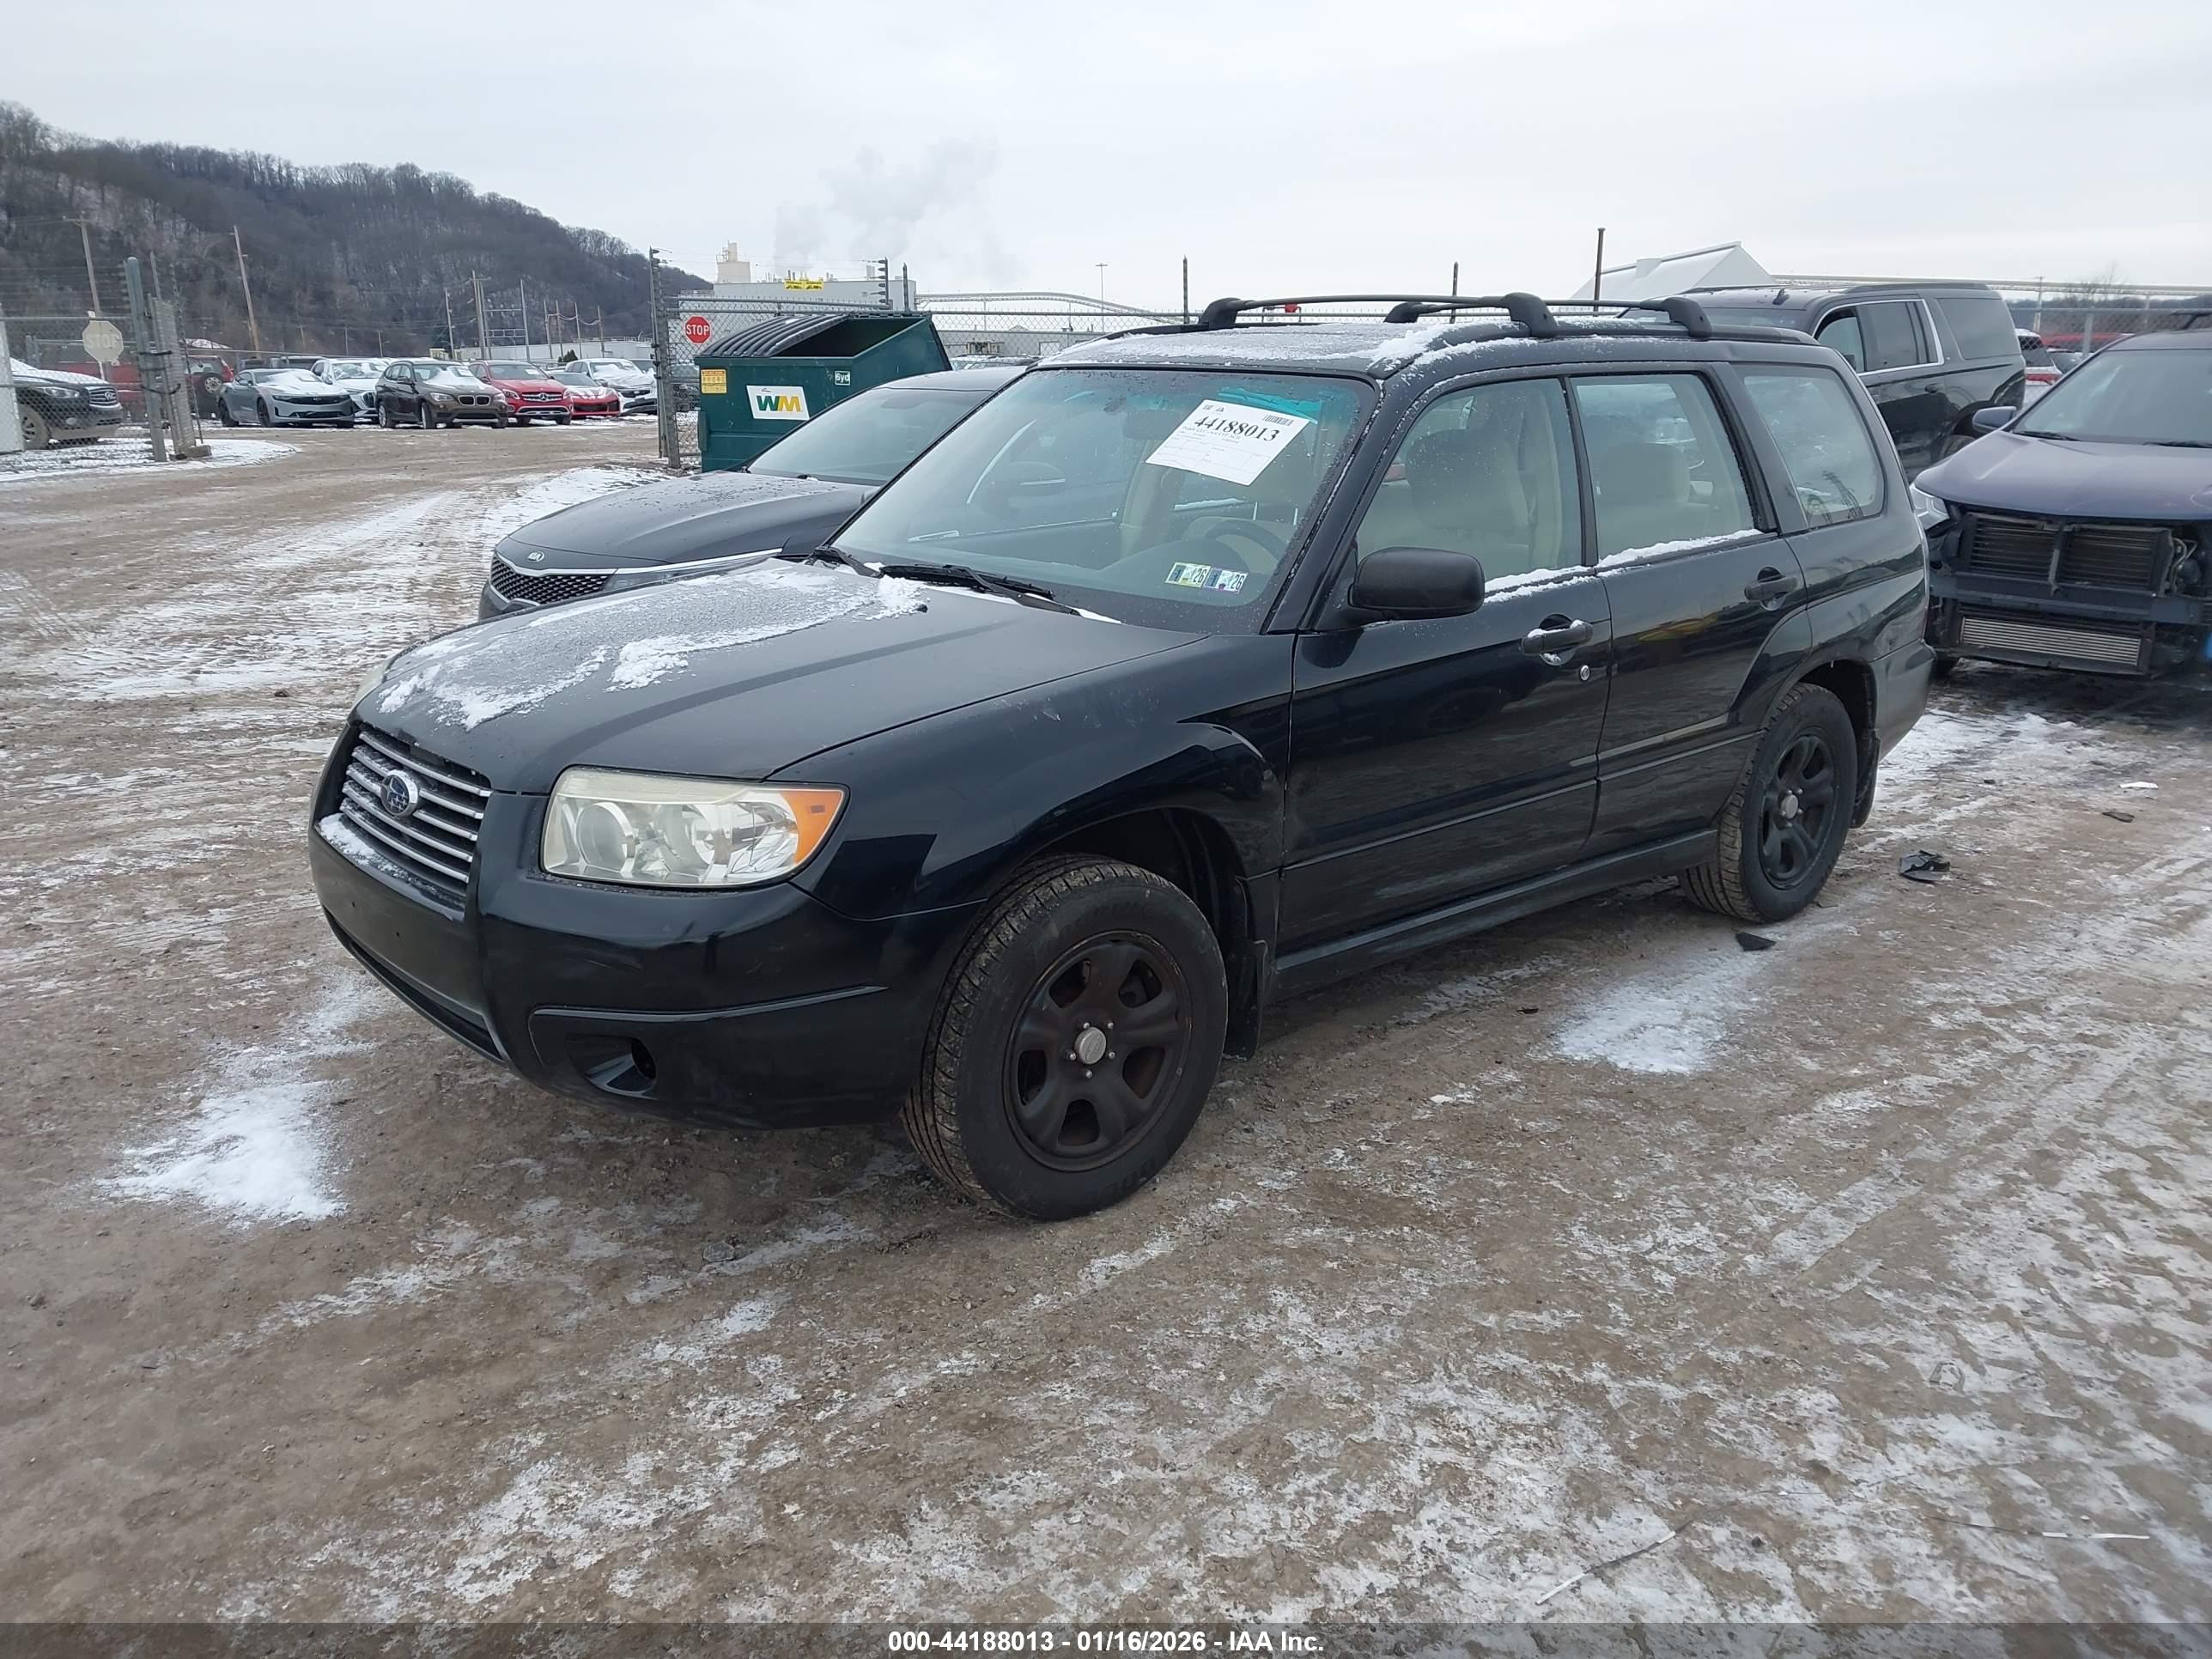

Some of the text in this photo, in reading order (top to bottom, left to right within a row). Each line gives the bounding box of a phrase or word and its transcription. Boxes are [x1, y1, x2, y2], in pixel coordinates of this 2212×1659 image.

[686, 325, 709, 336] STOP
[86, 333, 120, 349] STOP
[756, 395, 802, 412] WM
[1194, 416, 1280, 441] 44188013
[1193, 568, 1207, 584] 26
[1231, 574, 1245, 591] 26
